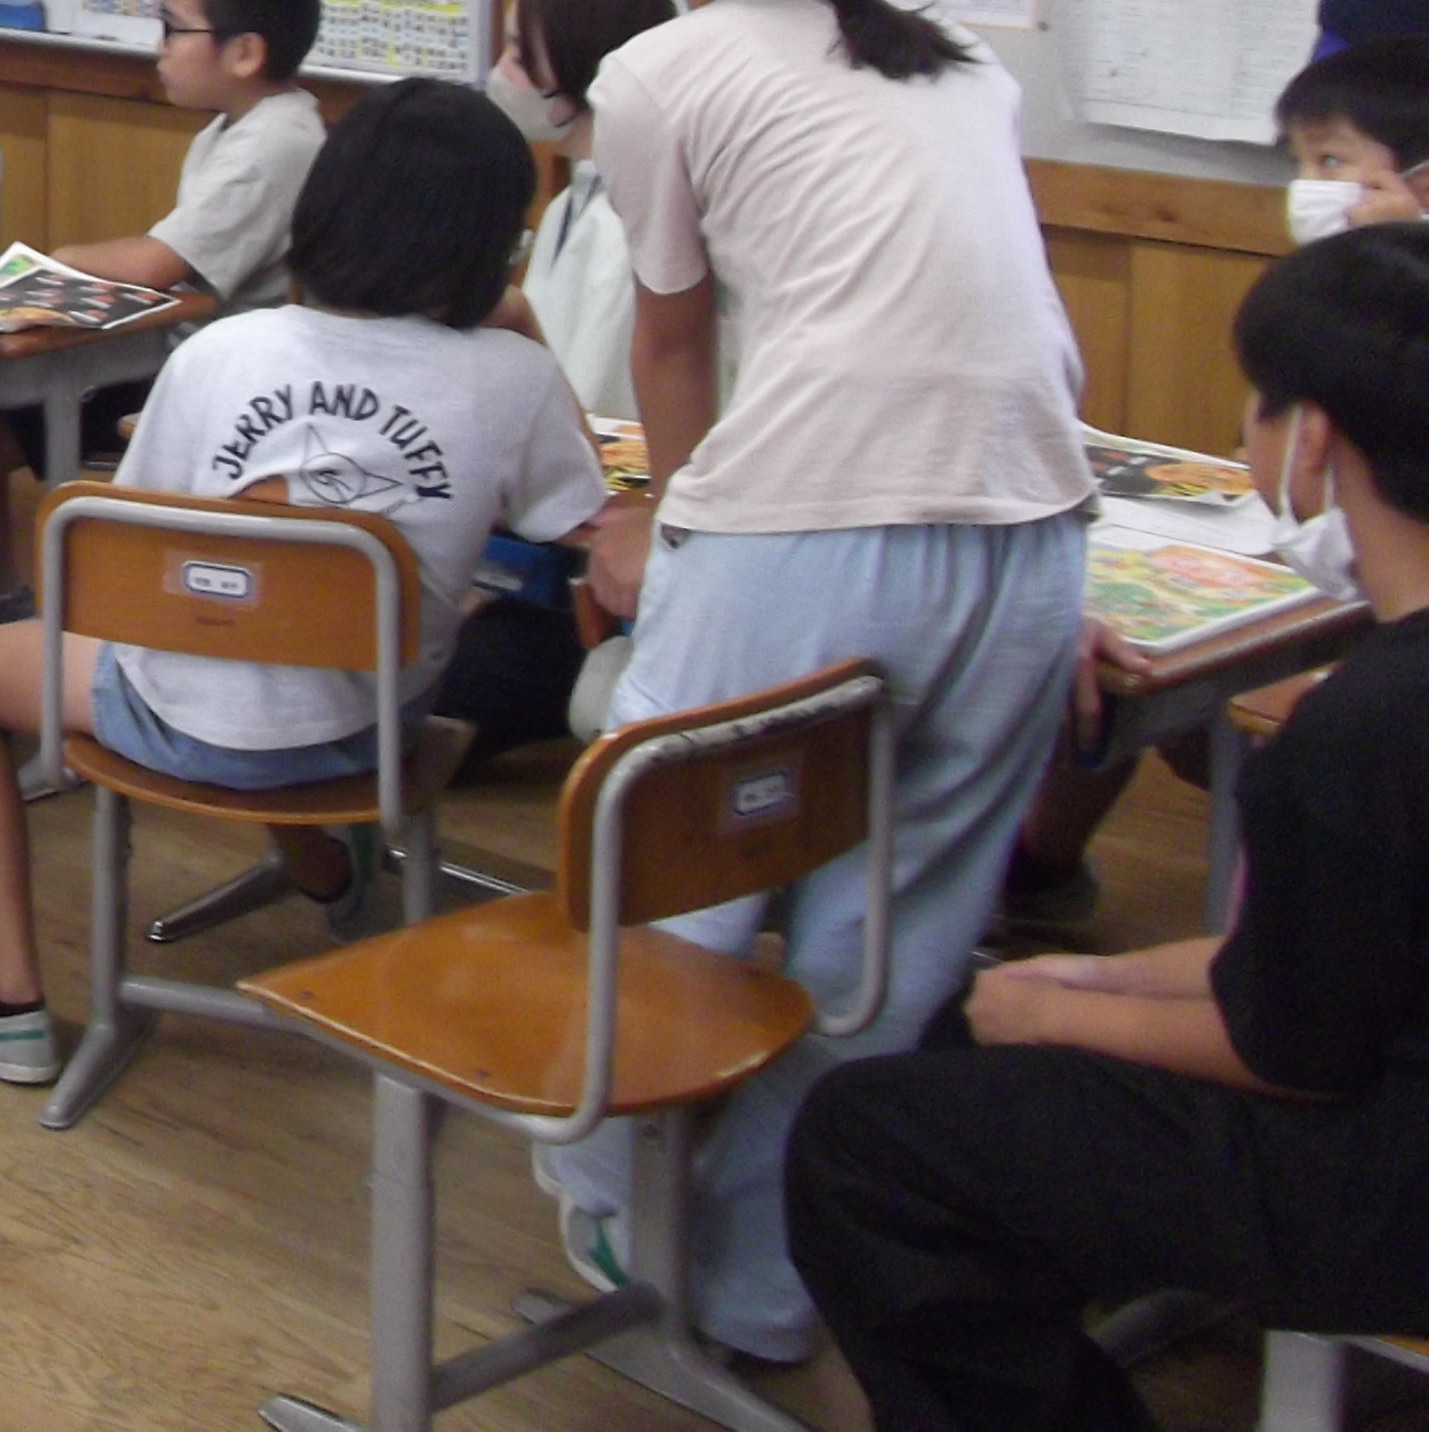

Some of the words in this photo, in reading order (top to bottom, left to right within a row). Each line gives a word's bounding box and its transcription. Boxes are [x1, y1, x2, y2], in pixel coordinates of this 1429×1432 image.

[212, 383, 293, 480] JERRY
[309, 381, 381, 421] AND
[379, 404, 455, 500] TUFFY
